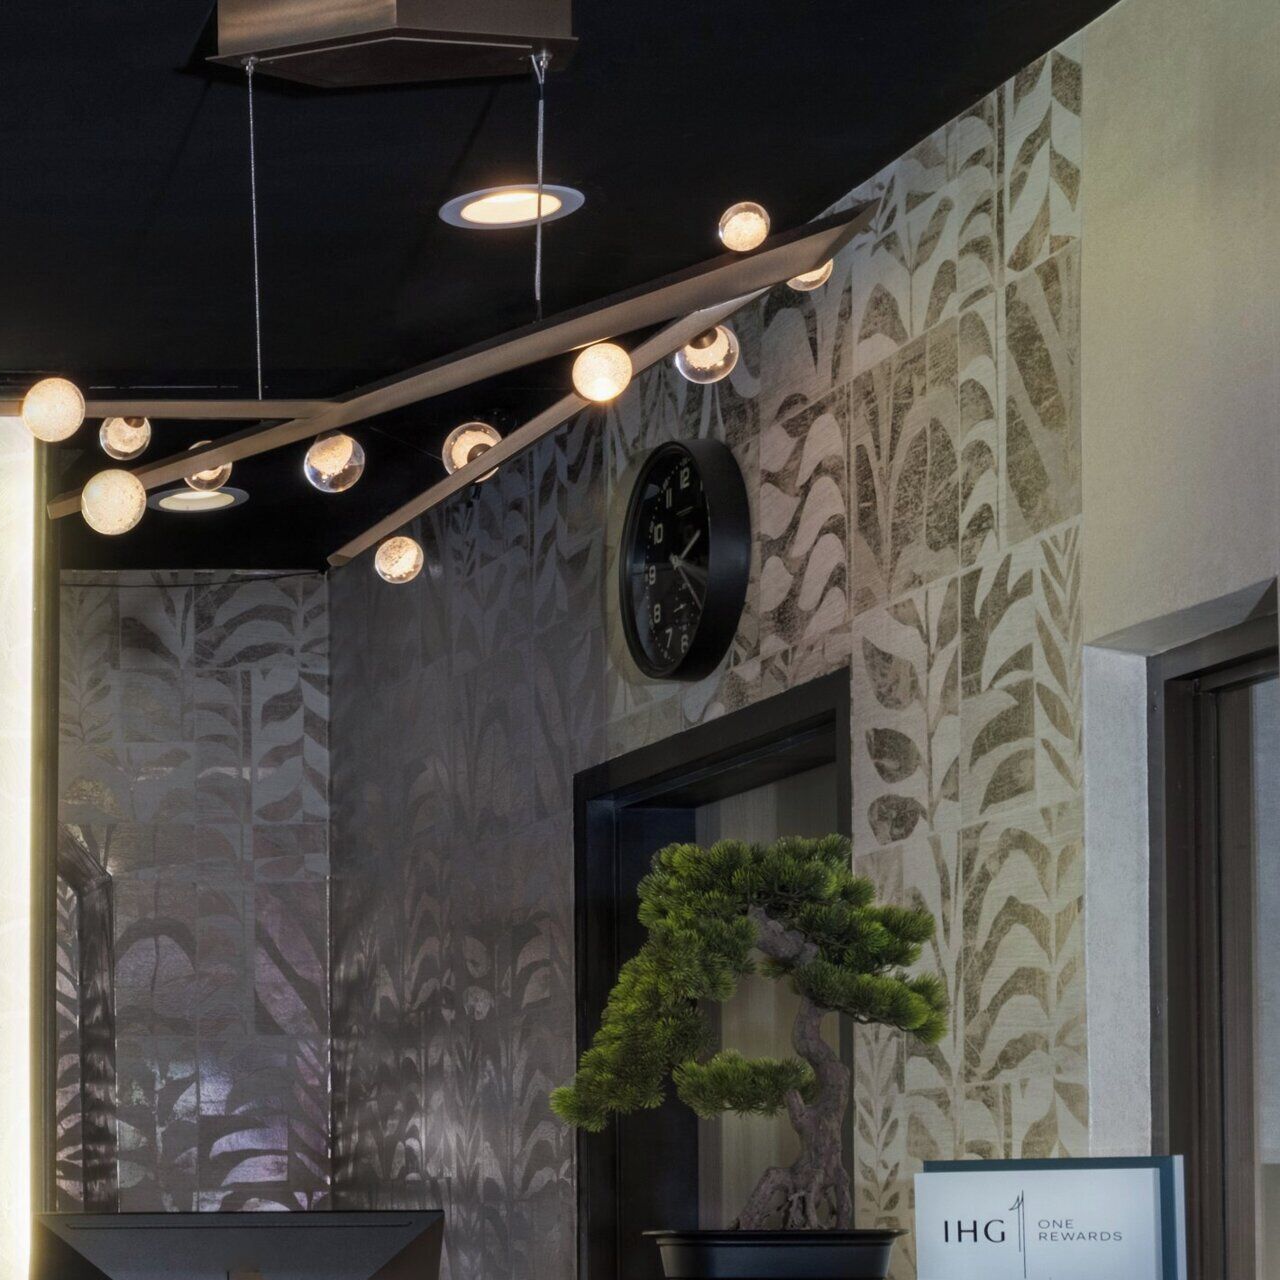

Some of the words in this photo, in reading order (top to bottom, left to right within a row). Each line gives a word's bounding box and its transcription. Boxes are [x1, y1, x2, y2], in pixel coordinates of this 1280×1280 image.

[680, 467, 690, 489] 12
[666, 489, 673, 509] 11
[654, 524, 663, 546] 10
[648, 565, 656, 585] 9
[653, 603, 661, 624] 8
[664, 629, 673, 649] 7
[681, 635, 689, 654] 6
[944, 1219, 1006, 1243] IHG
[1038, 1219, 1073, 1230] ONE
[1038, 1231, 1123, 1242] REWARDS
